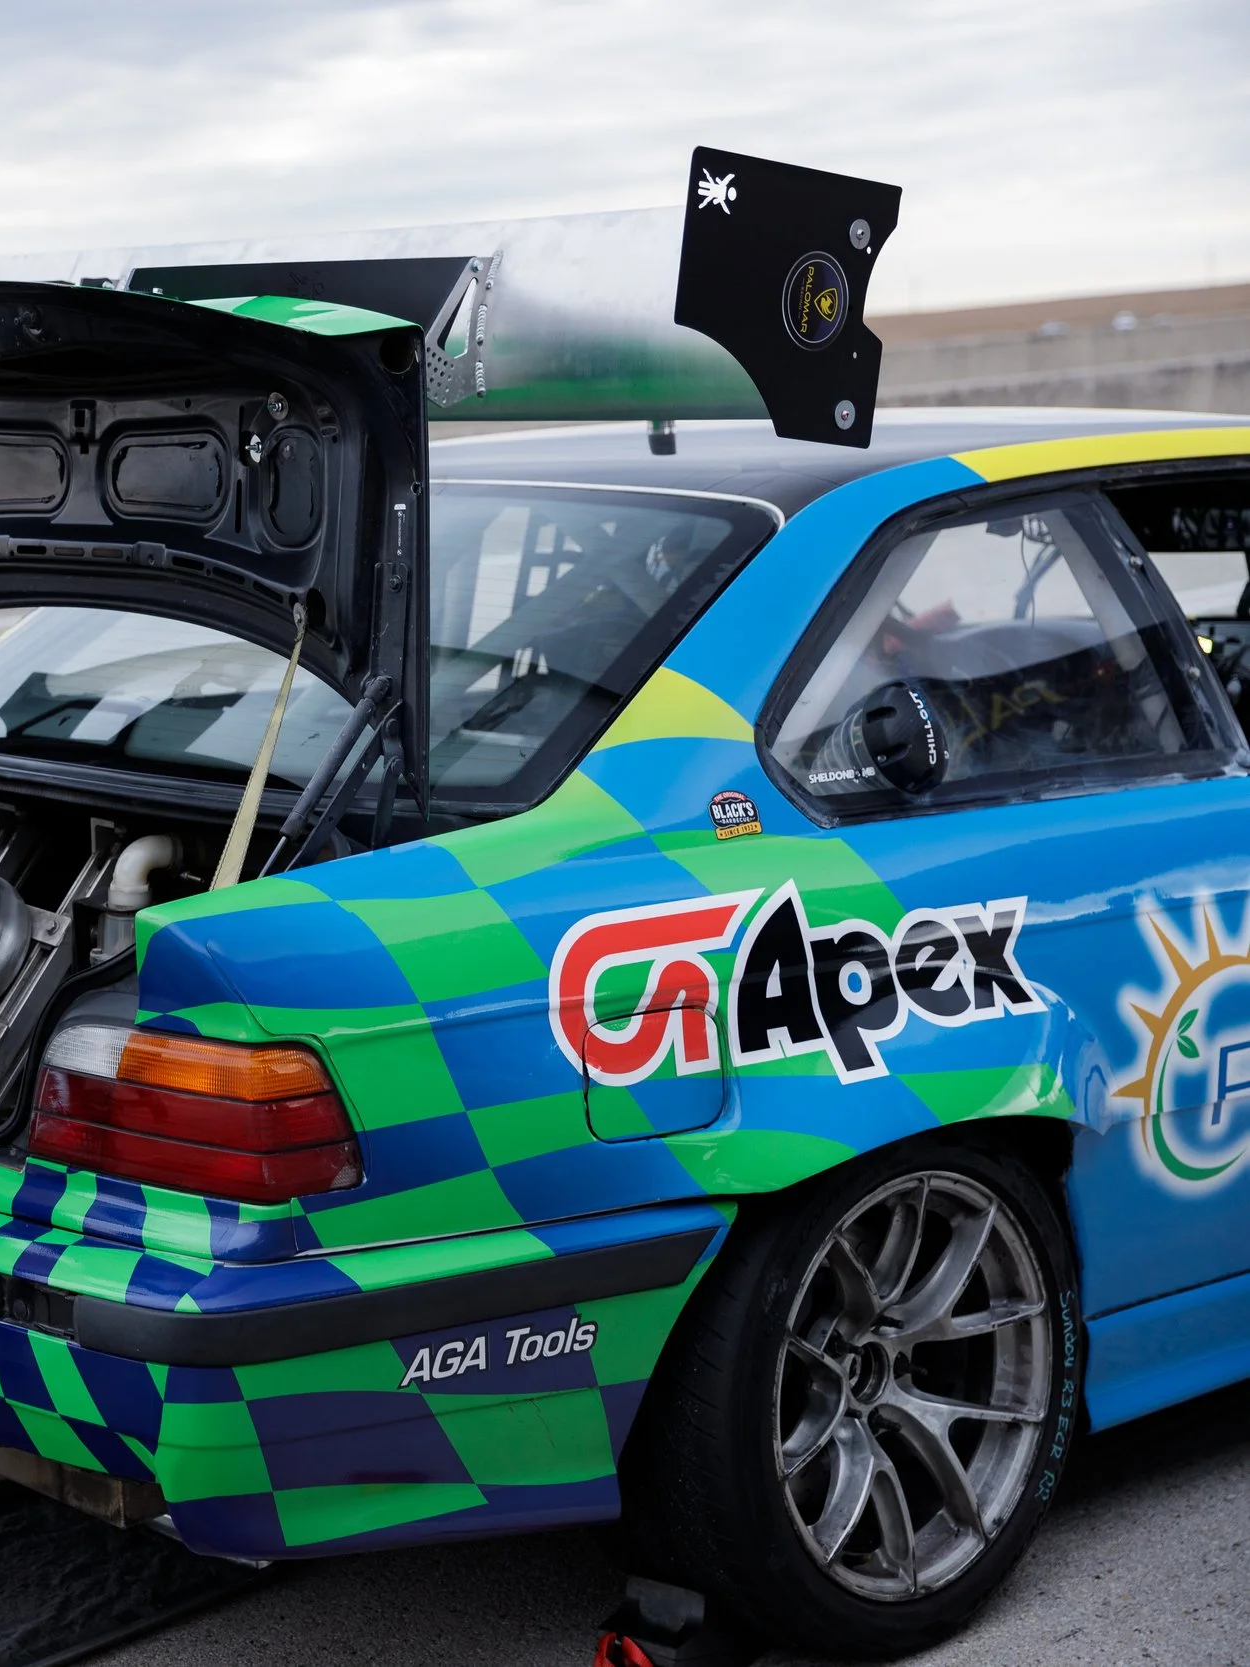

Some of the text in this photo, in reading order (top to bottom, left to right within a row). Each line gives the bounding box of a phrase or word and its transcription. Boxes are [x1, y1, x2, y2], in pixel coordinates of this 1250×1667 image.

[800, 266, 815, 334] PALOMAR
[909, 688, 937, 765] CHILLOUT
[808, 766, 876, 784] SHELDONBMB
[711, 802, 755, 819] BLACK'S
[724, 826, 740, 837] SINCE
[735, 890, 1038, 1075] Apex
[399, 1317, 596, 1387] AGA Tools
